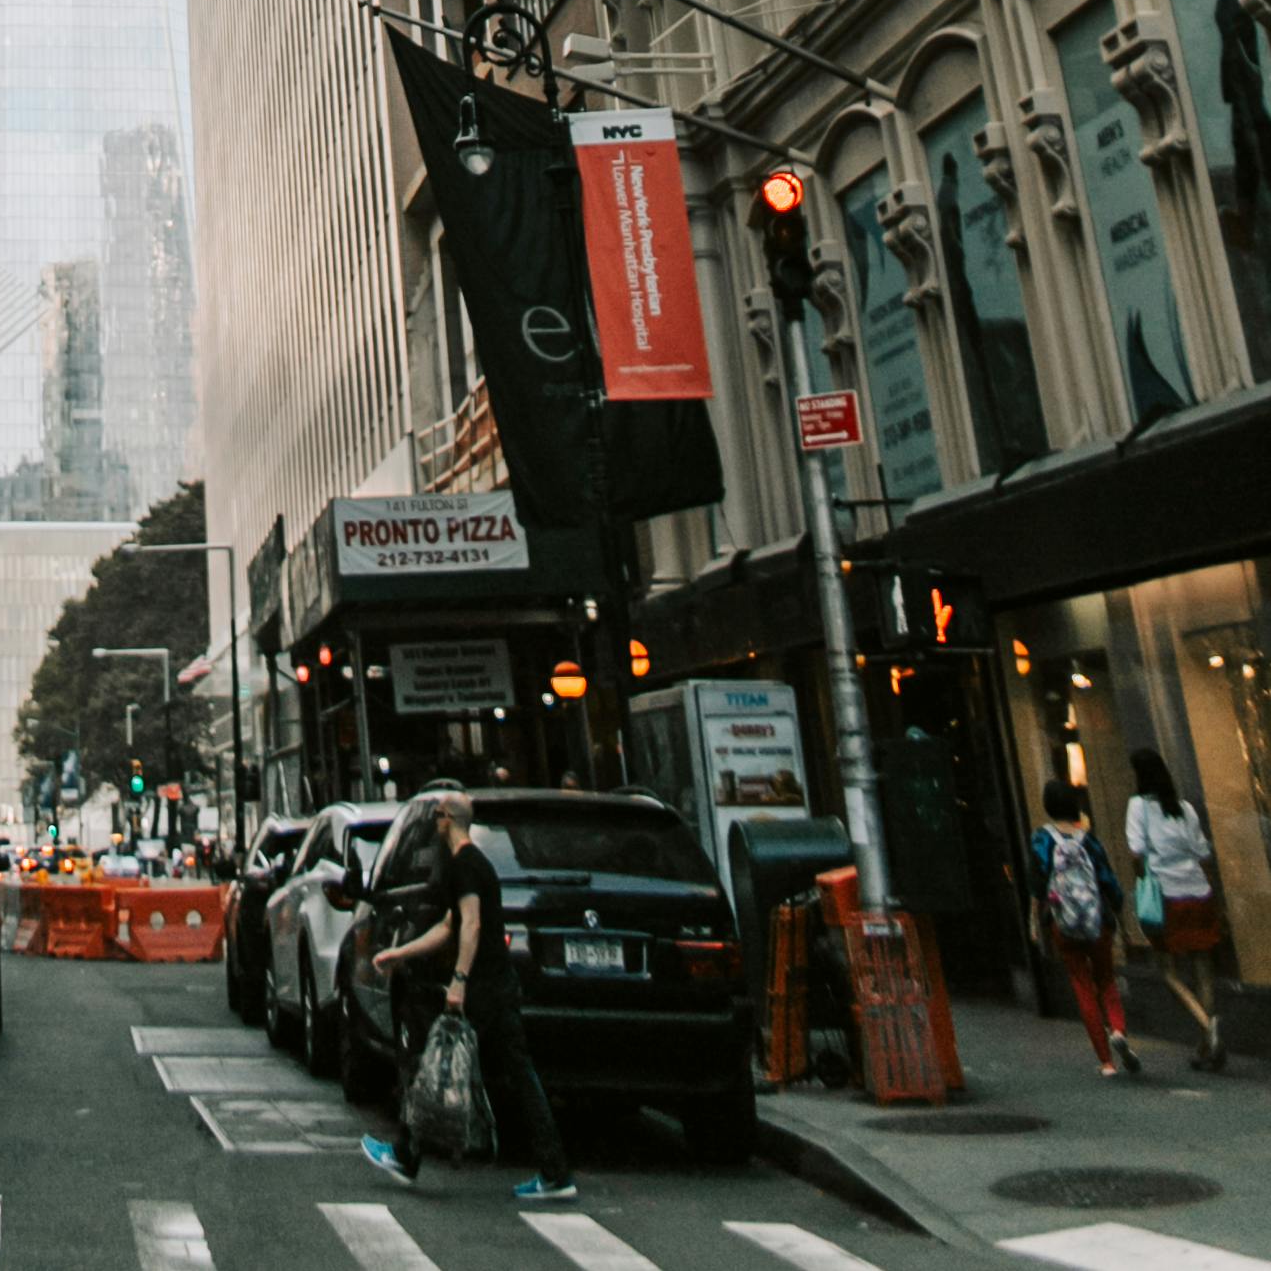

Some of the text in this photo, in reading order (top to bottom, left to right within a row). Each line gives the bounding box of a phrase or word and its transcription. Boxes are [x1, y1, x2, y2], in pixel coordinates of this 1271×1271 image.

[602, 124, 643, 139] NYC
[612, 166, 653, 352] Lower Manhattan Hospital
[799, 396, 847, 412] NO STANDING
[385, 499, 407, 512] 141
[410, 499, 454, 512] FULTON
[343, 514, 517, 547] PRONTO PIZZA
[377, 548, 490, 567] 212-732-4131
[724, 692, 770, 706] TITAN
